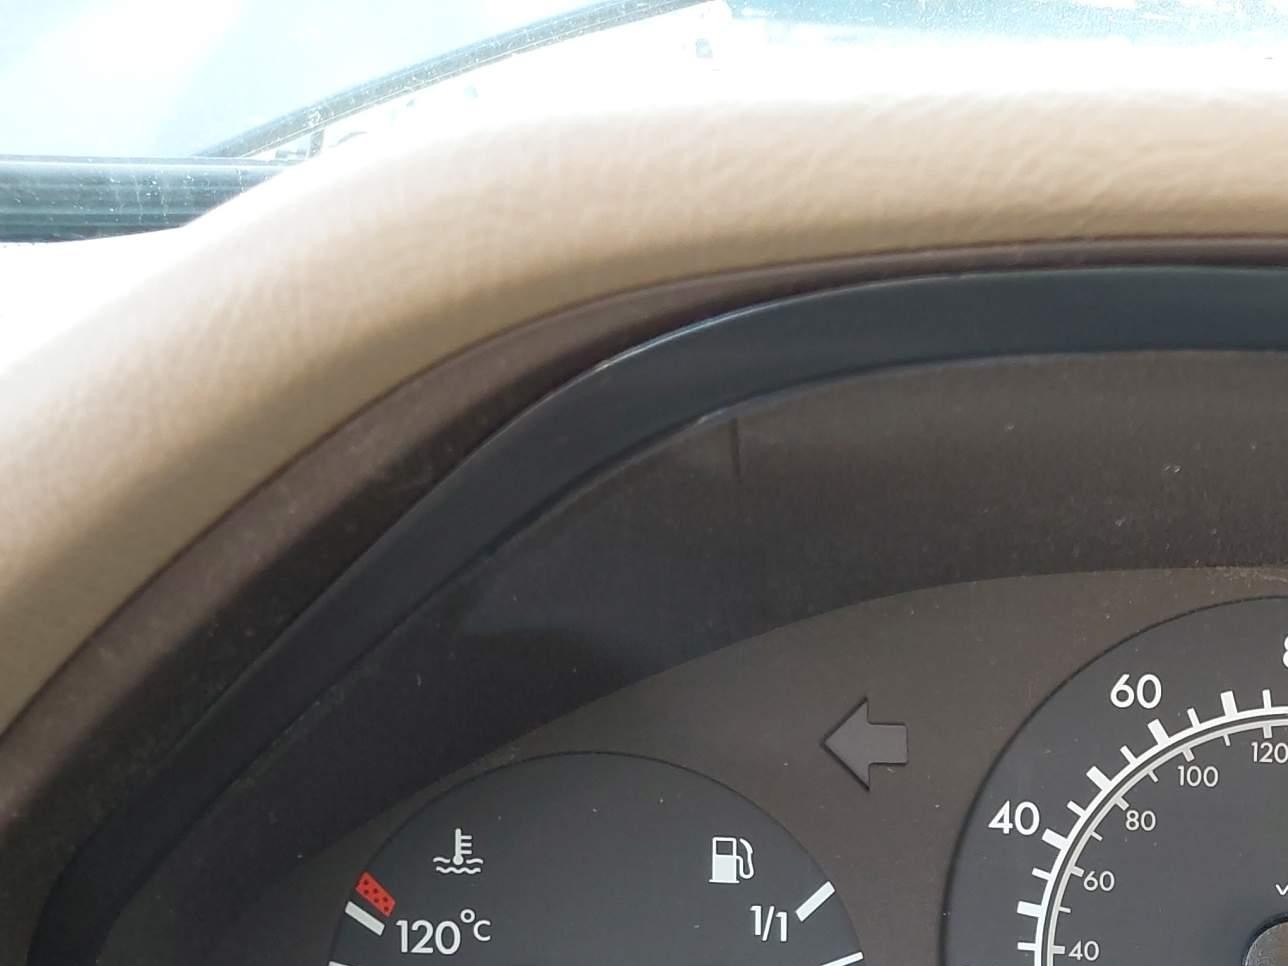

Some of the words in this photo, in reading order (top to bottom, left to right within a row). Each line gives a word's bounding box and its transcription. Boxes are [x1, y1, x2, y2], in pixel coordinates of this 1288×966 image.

[1110, 674, 1162, 709] 60
[1177, 765, 1219, 787] 100
[988, 800, 1040, 836] 40
[1124, 811, 1156, 831] 80
[1083, 868, 1115, 892] 60
[750, 905, 788, 942] 1/1
[1068, 940, 1100, 961] 40
